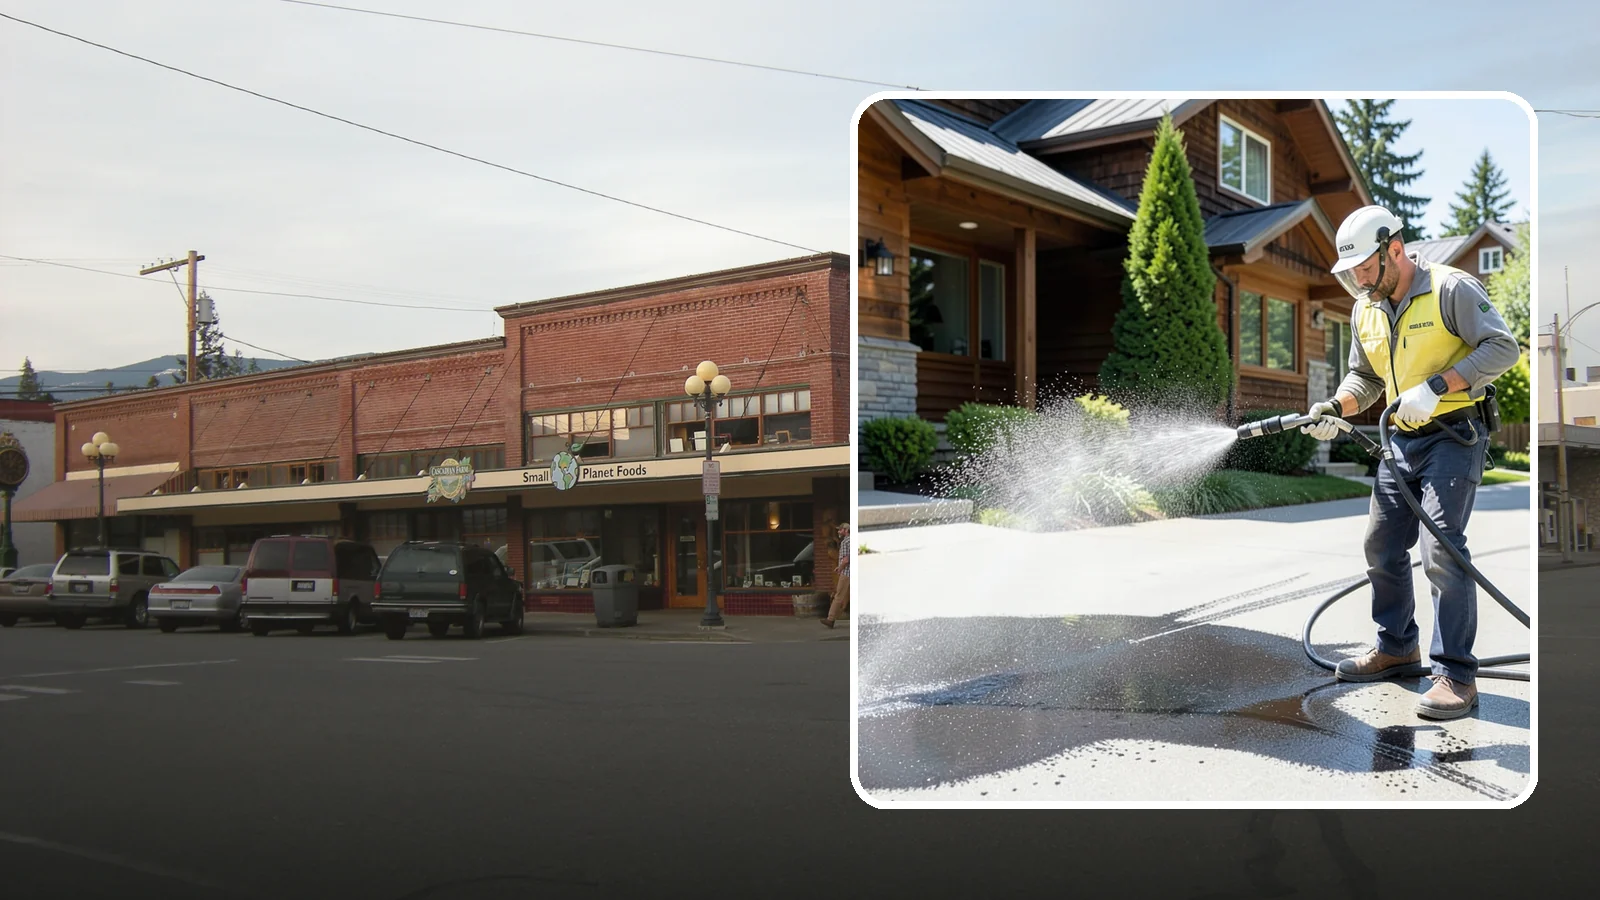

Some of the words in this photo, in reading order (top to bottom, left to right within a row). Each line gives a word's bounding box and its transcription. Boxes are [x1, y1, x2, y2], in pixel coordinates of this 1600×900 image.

[523, 471, 549, 483] Small
[583, 467, 614, 479] Planet
[617, 464, 647, 477] Foods
